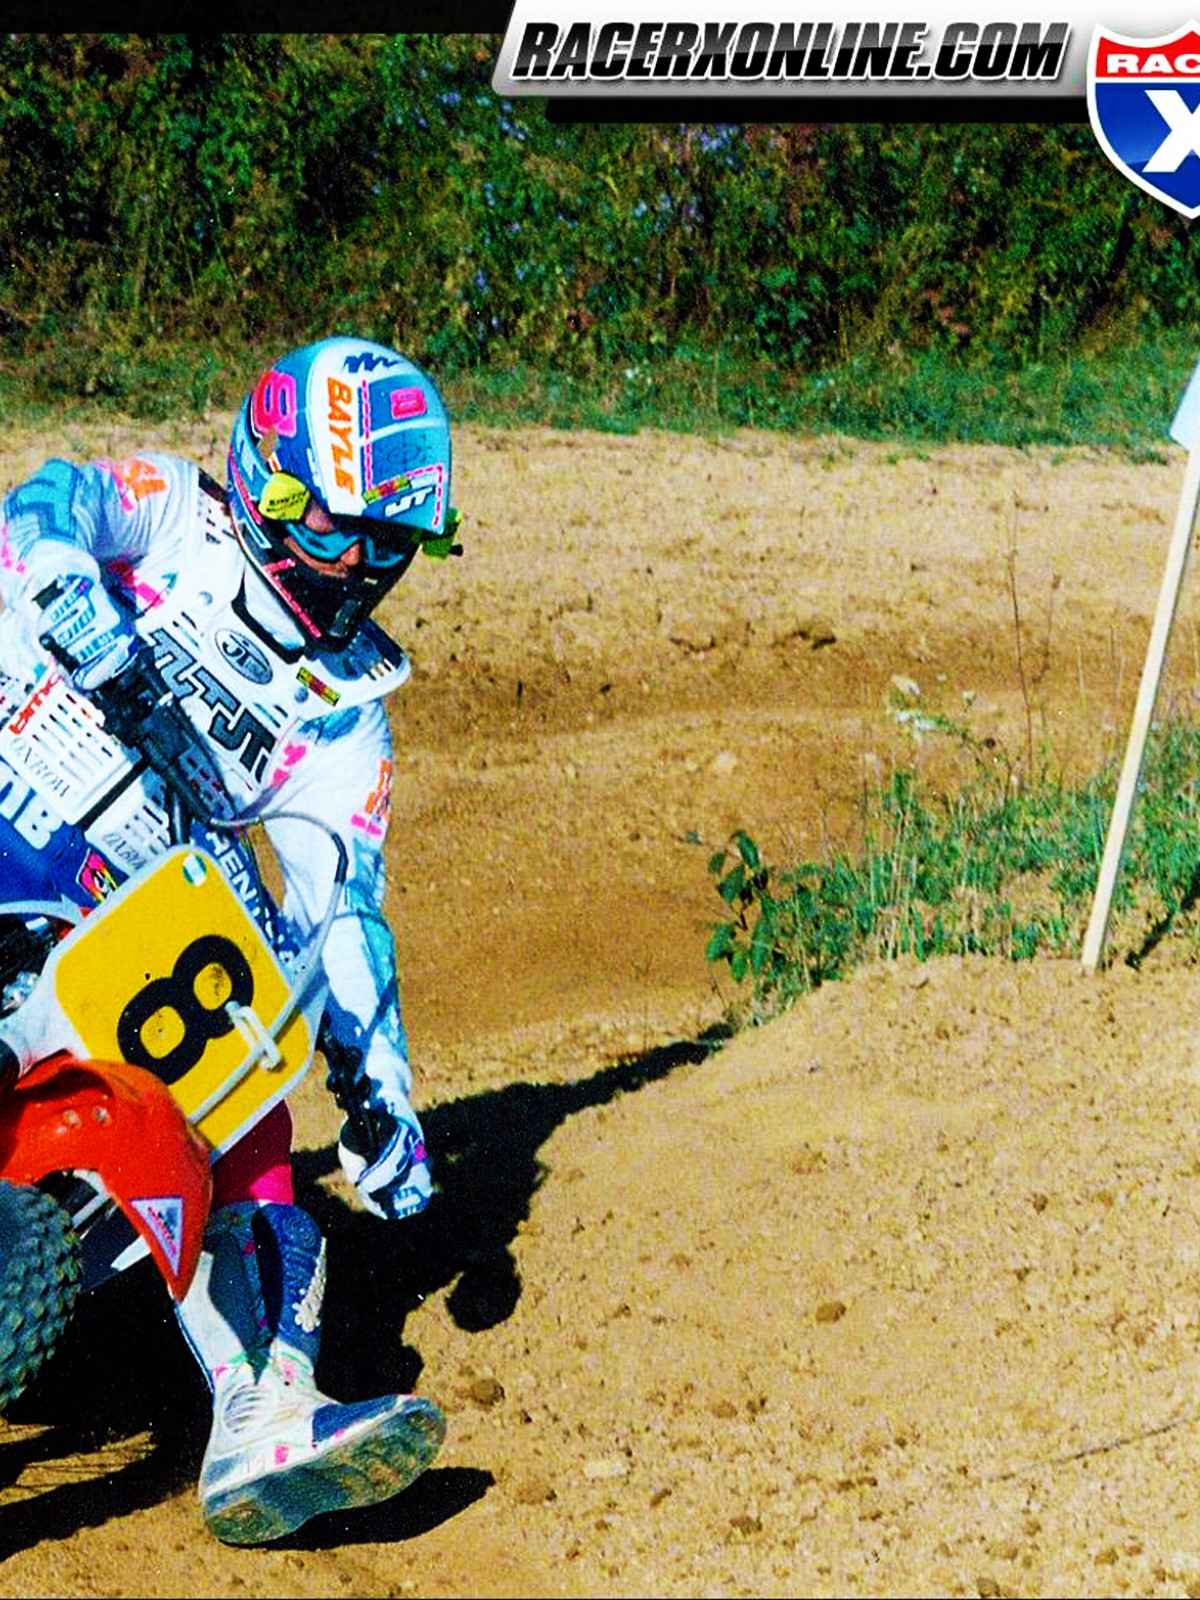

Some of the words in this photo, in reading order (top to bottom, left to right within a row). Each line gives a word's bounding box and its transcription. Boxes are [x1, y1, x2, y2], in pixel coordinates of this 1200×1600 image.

[327, 376, 356, 496] BAYLE
[384, 485, 436, 517] JT
[117, 934, 254, 1086] 8
